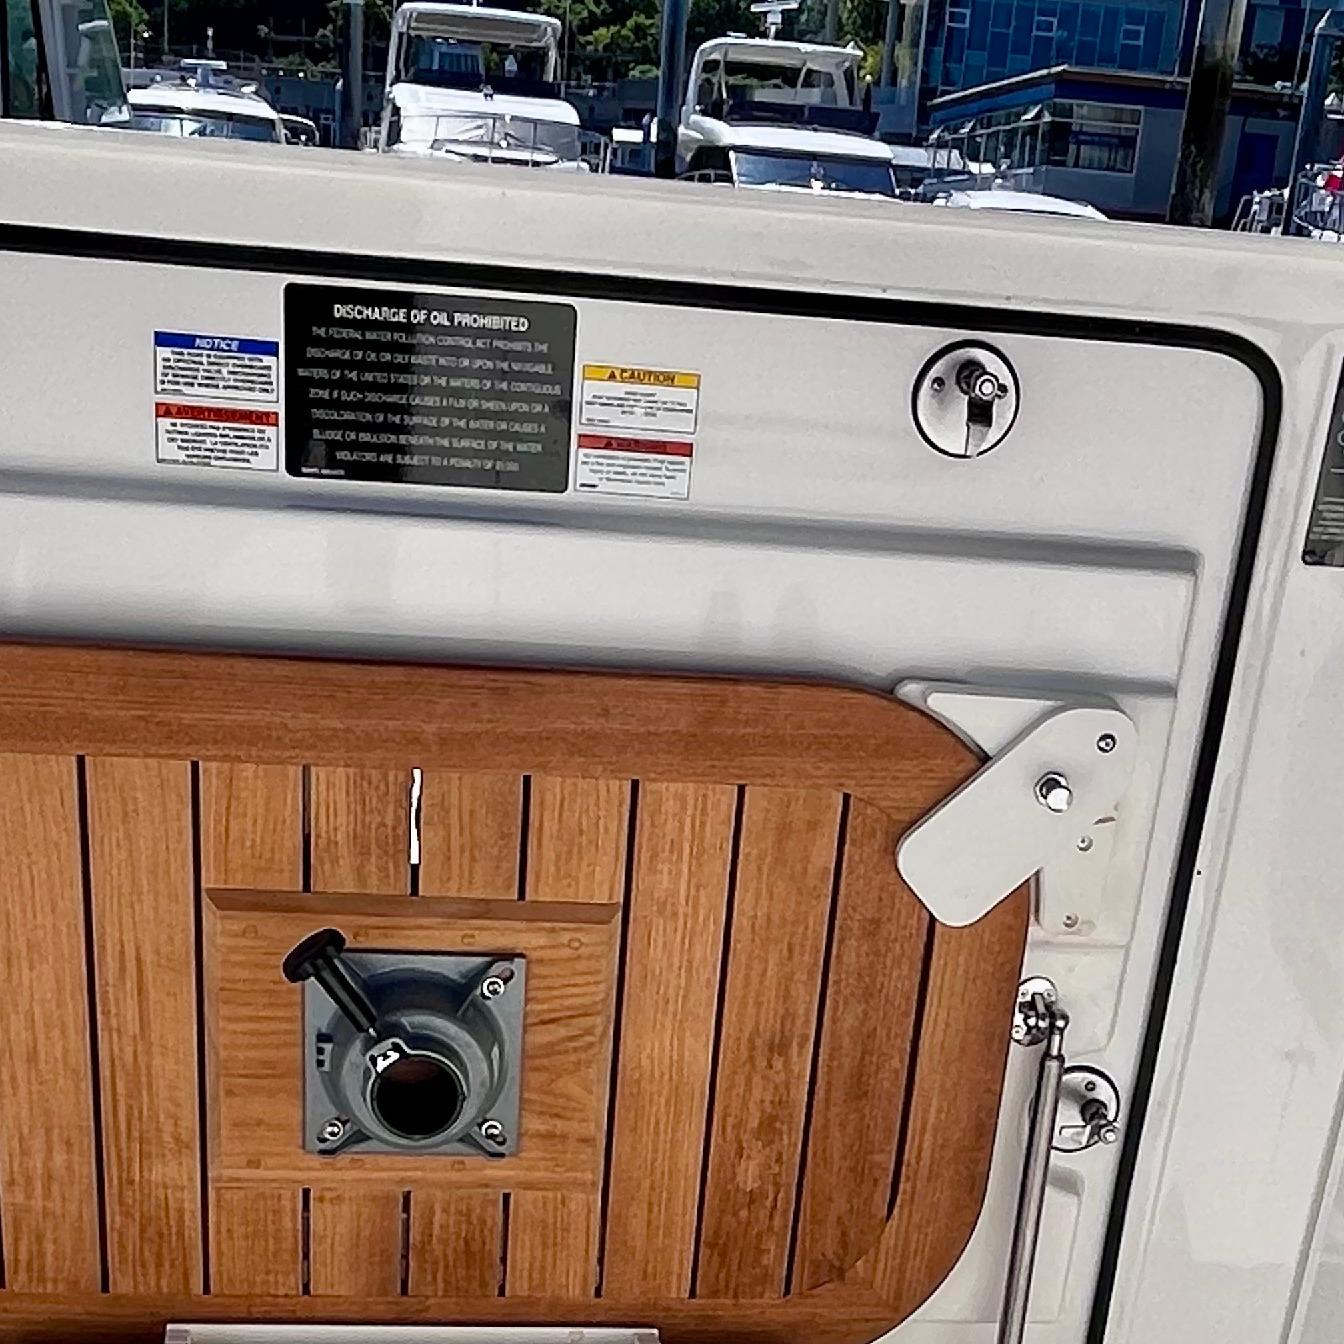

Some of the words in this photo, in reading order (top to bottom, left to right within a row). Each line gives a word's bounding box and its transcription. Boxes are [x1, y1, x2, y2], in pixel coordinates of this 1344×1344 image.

[333, 302, 407, 323] DISCHARGE
[410, 308, 427, 325] OF
[430, 309, 450, 326] OIL
[452, 311, 528, 333] PROHIBITED
[194, 336, 240, 351] NOTICE
[620, 369, 675, 384] CAUTION
